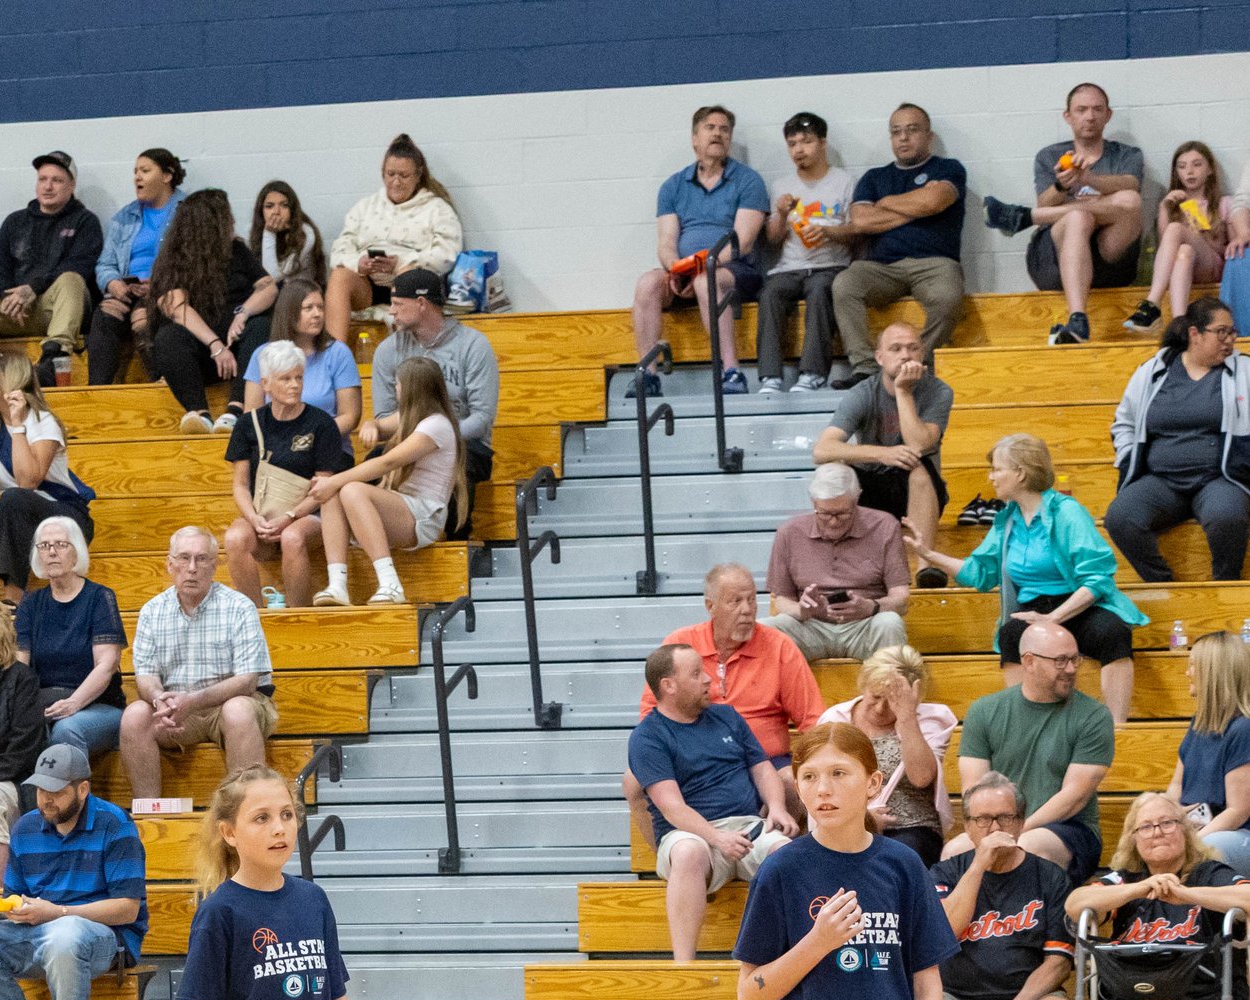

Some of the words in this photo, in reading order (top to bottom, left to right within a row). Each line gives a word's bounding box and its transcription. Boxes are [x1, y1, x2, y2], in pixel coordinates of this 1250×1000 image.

[959, 900, 1044, 943] etroit
[265, 942, 297, 960] ALL
[298, 939, 325, 955] STA
[253, 955, 327, 980] BASKETBA
